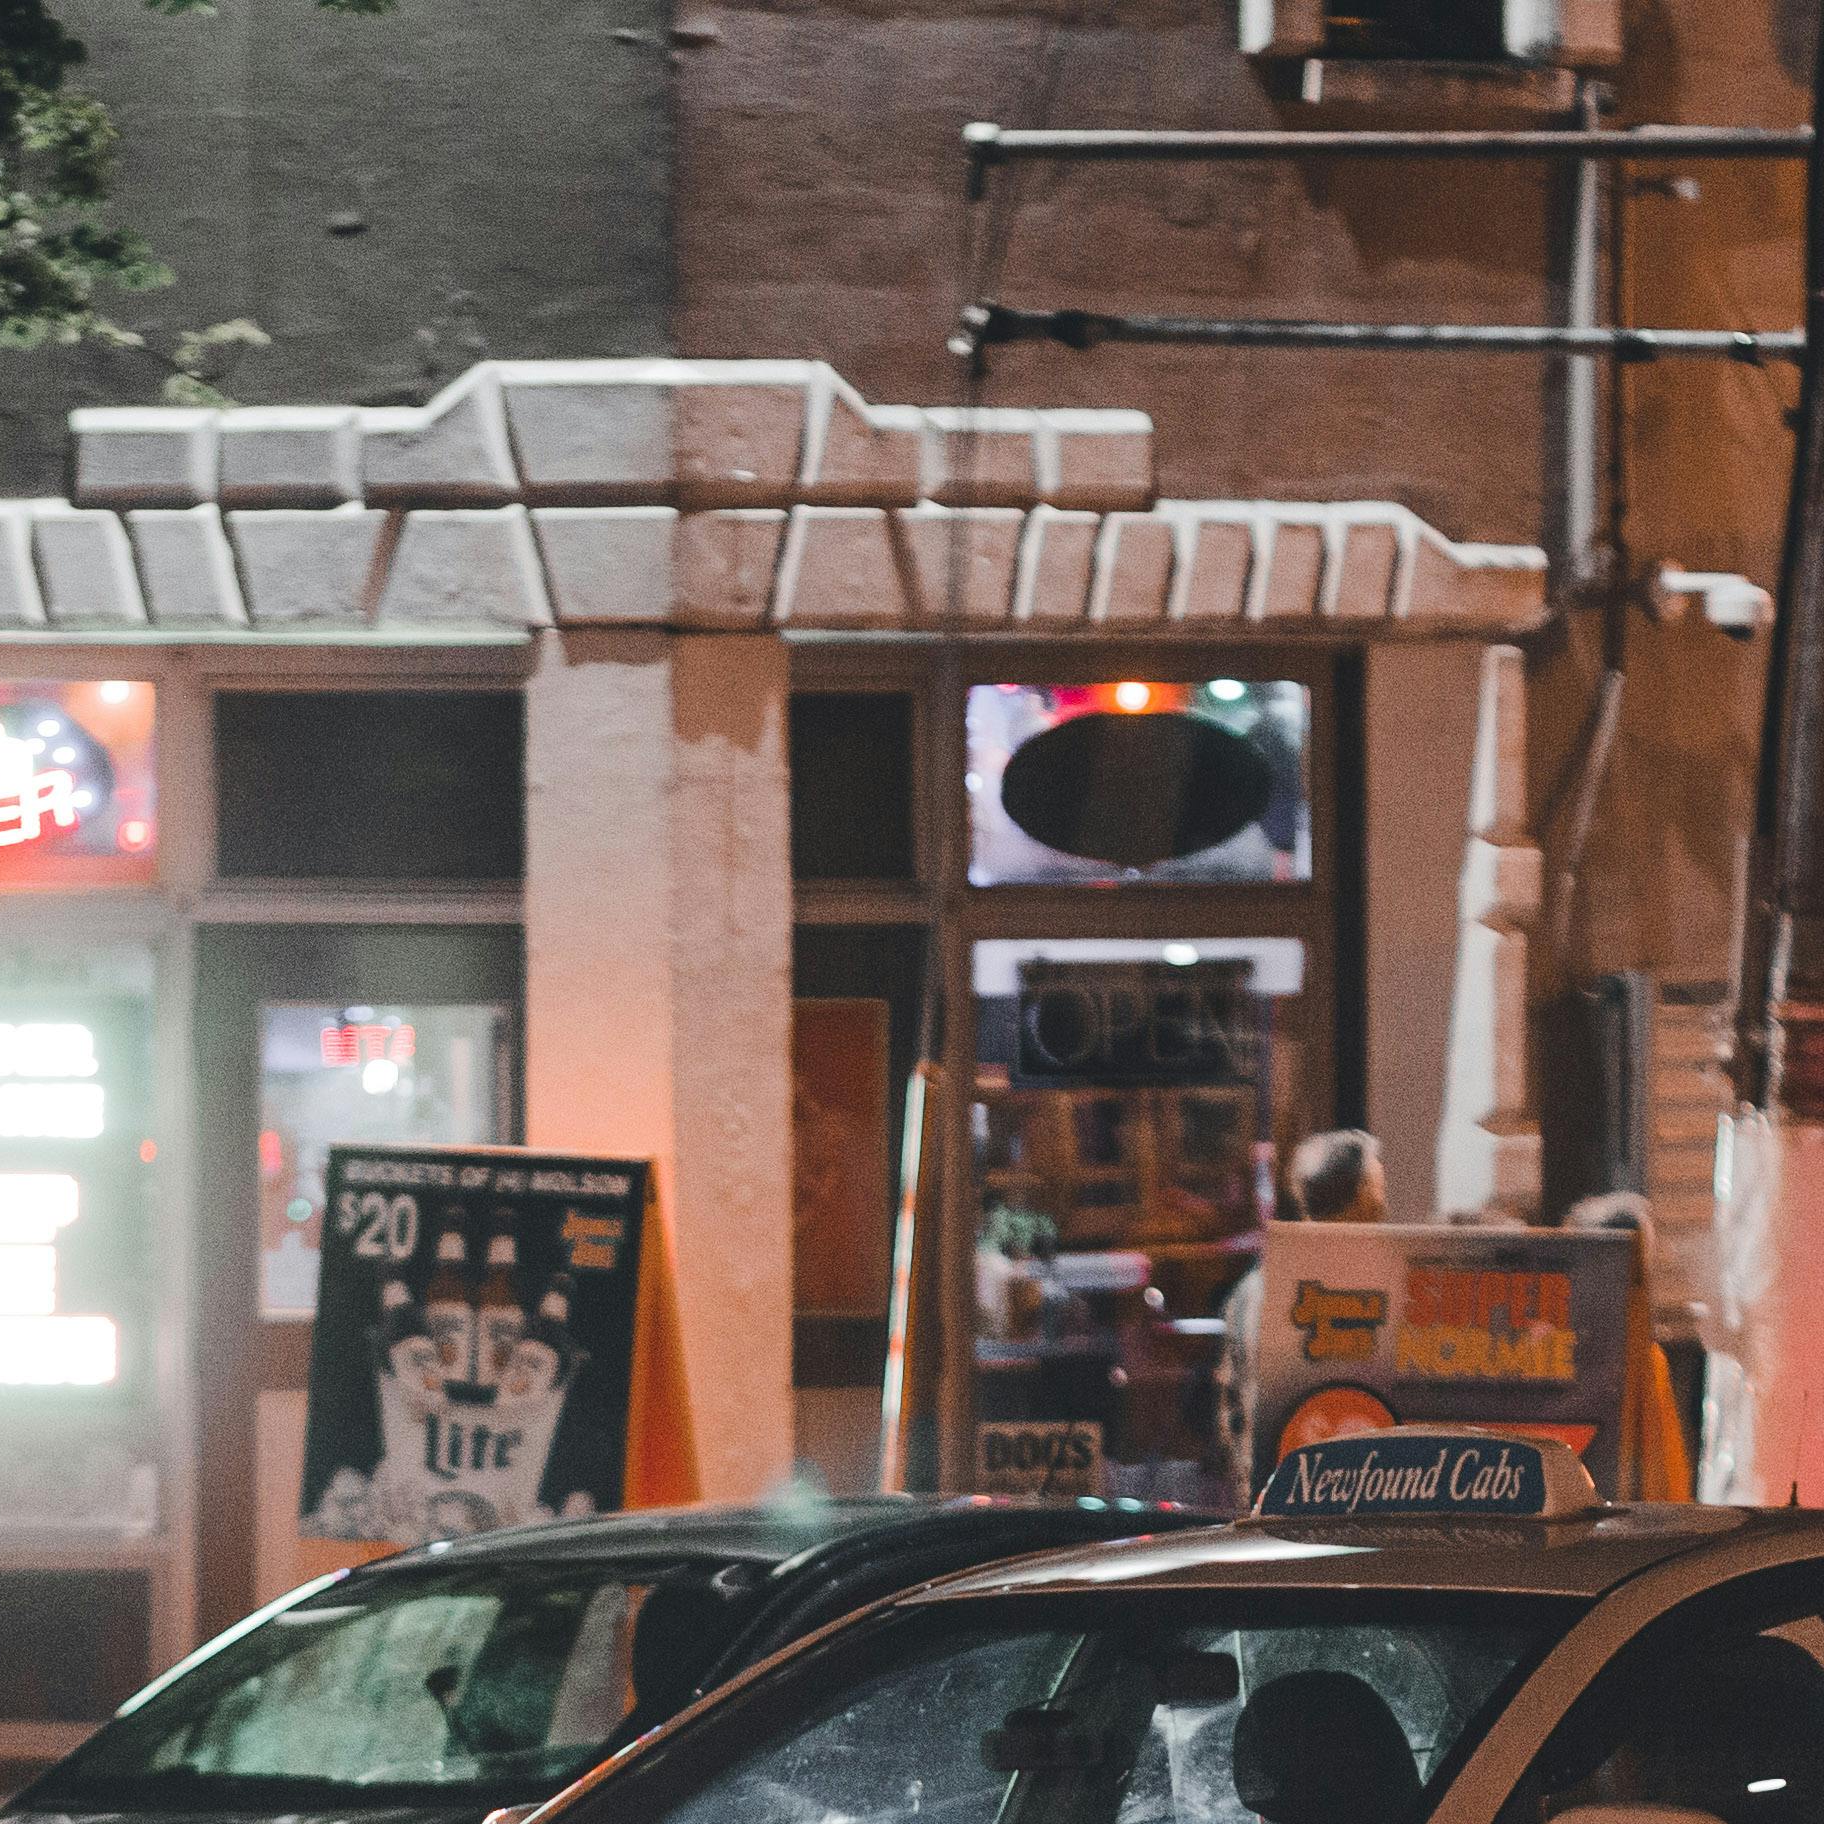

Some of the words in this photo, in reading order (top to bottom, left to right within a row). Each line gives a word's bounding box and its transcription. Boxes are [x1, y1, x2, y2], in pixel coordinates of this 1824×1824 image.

[337, 1190, 419, 1260] $20
[1405, 1267, 1572, 1329] SUPER
[1285, 1447, 1448, 1514] Newfound
[1449, 1447, 1526, 1502] Cabs
